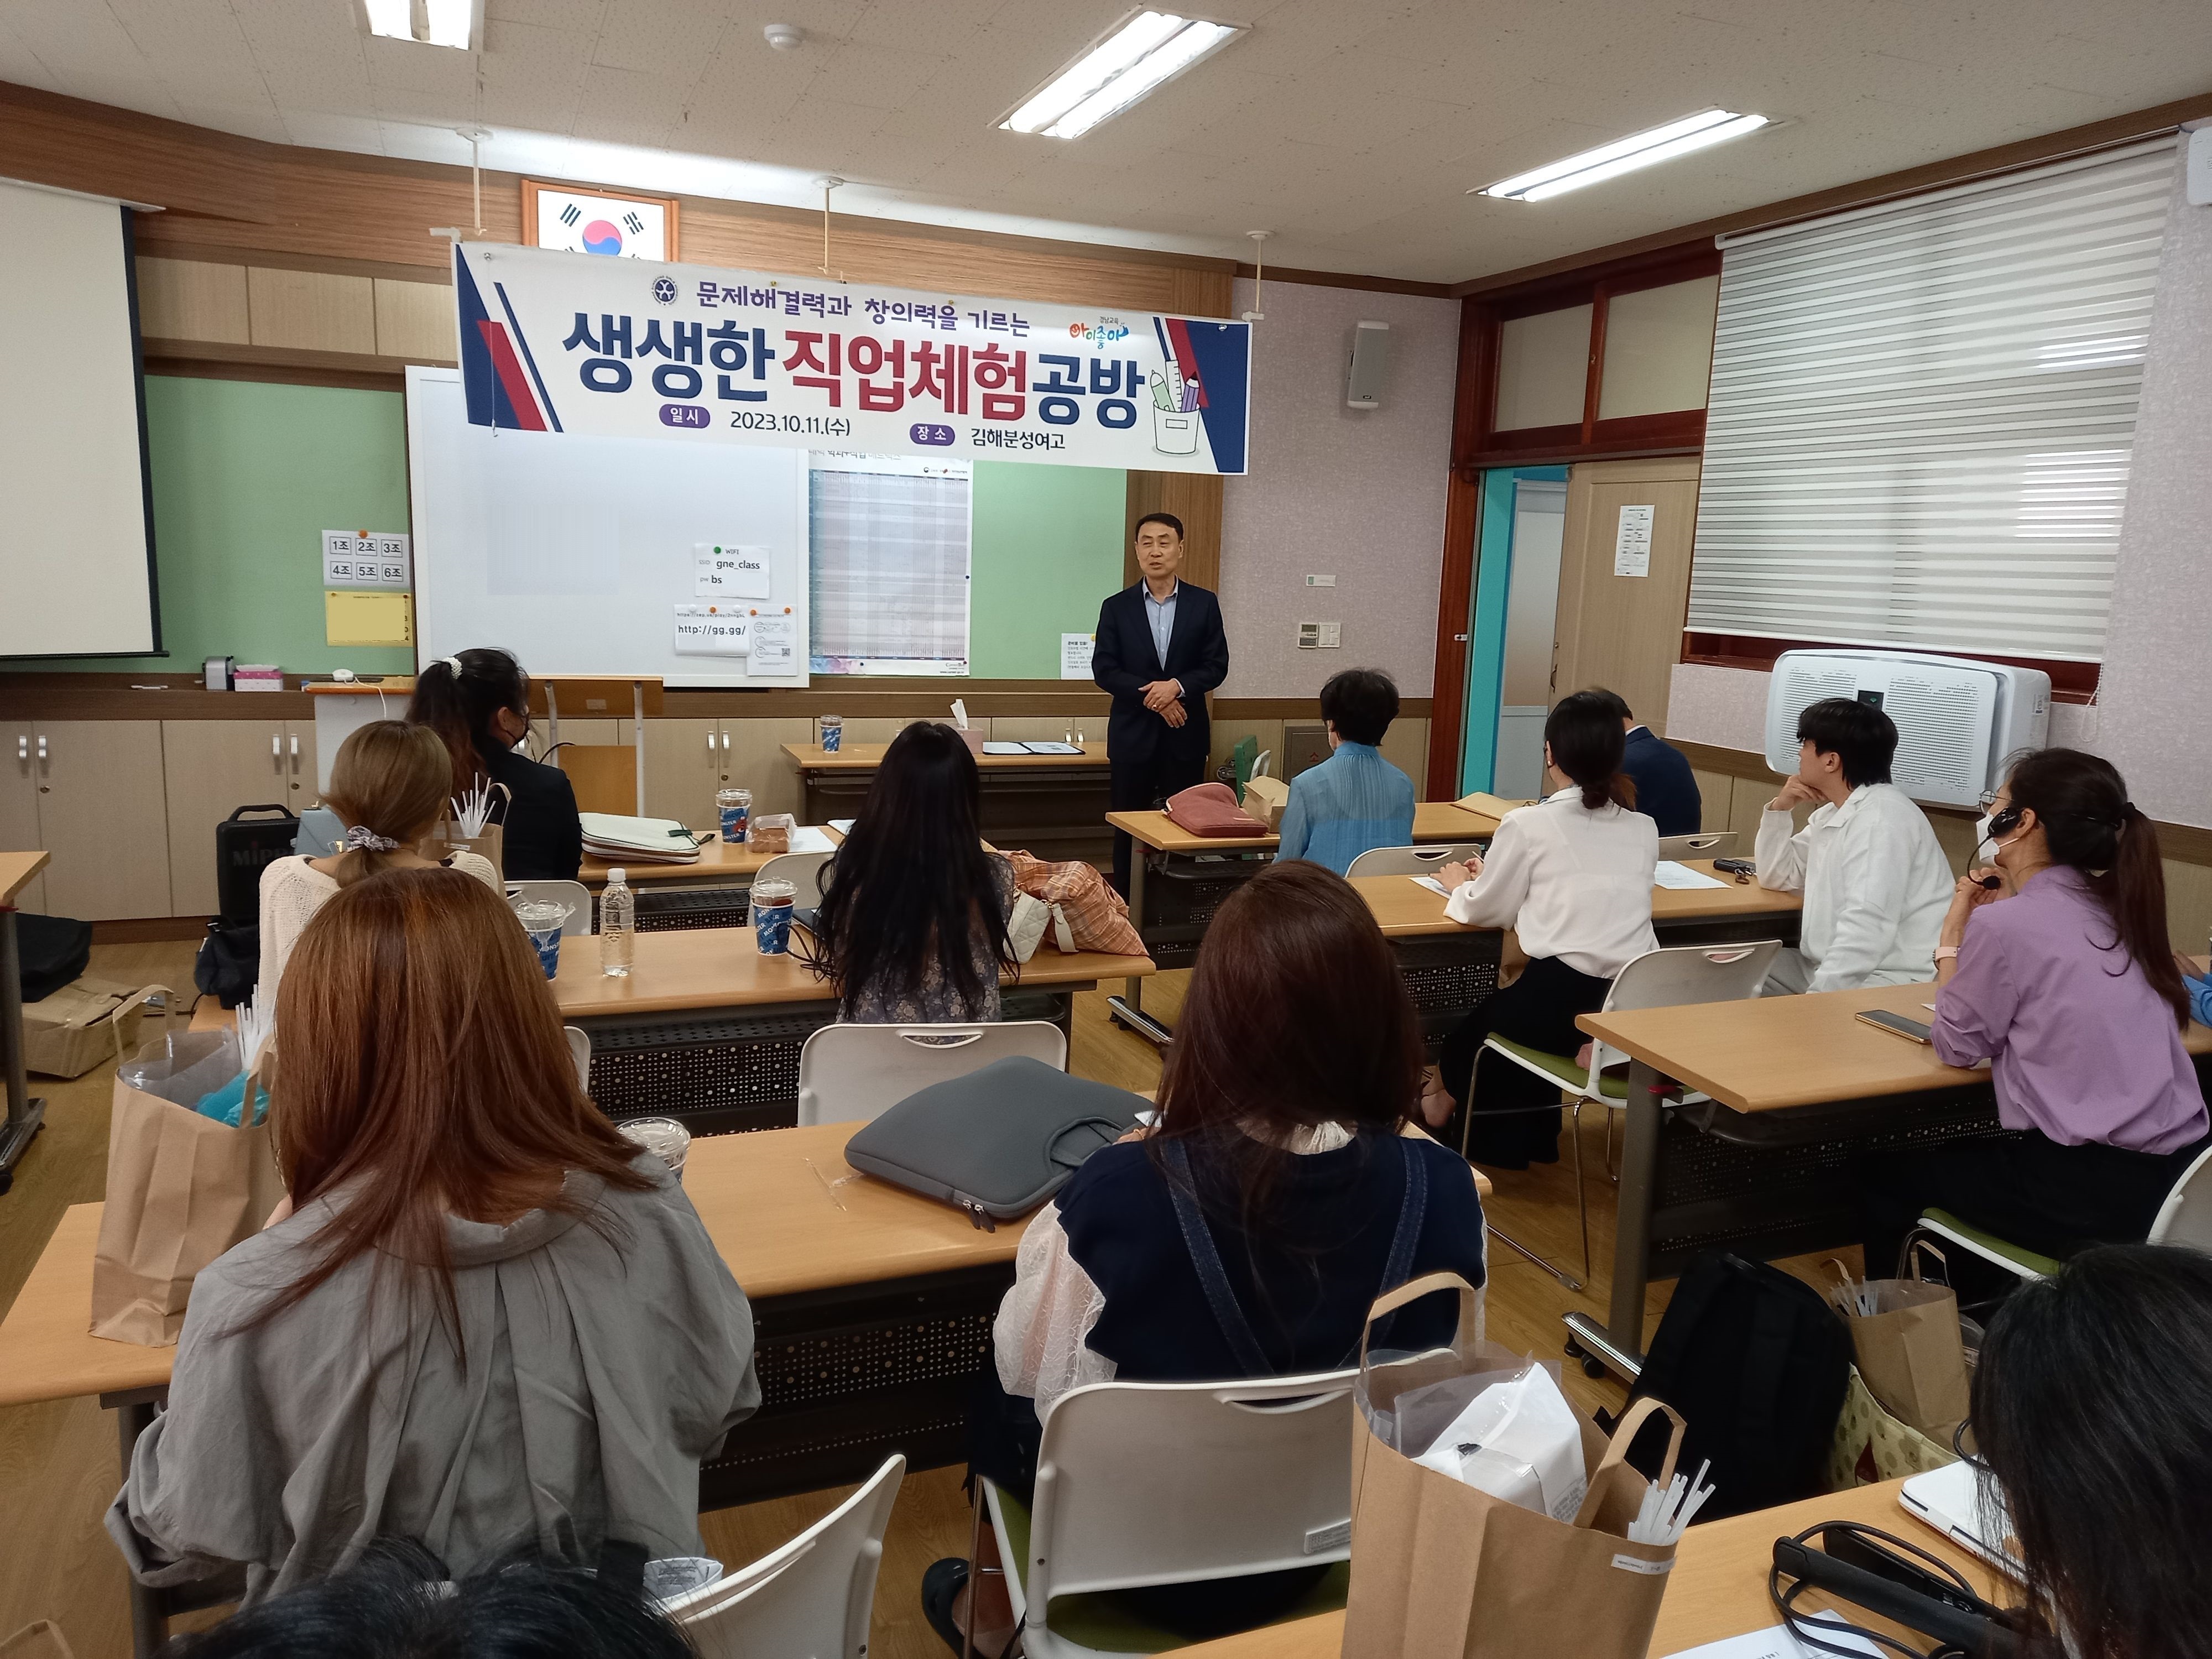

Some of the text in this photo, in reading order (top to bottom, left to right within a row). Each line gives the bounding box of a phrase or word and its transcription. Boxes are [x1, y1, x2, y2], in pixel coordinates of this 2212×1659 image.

[697, 281, 852, 318] 문제해결력과
[864, 299, 958, 331] 창의력을
[968, 311, 1030, 338] 기르는
[562, 312, 1145, 430] 생생한 직업체험 공방
[670, 408, 851, 437] 일시 2023.10.11.(수)
[916, 426, 1066, 451] 장소 김해분성여고
[332, 540, 401, 553] 1조 2조 3조
[332, 565, 403, 577] 4조 5조 6조
[716, 560, 760, 570] gne_class
[678, 625, 746, 635] http://gg.gg/
